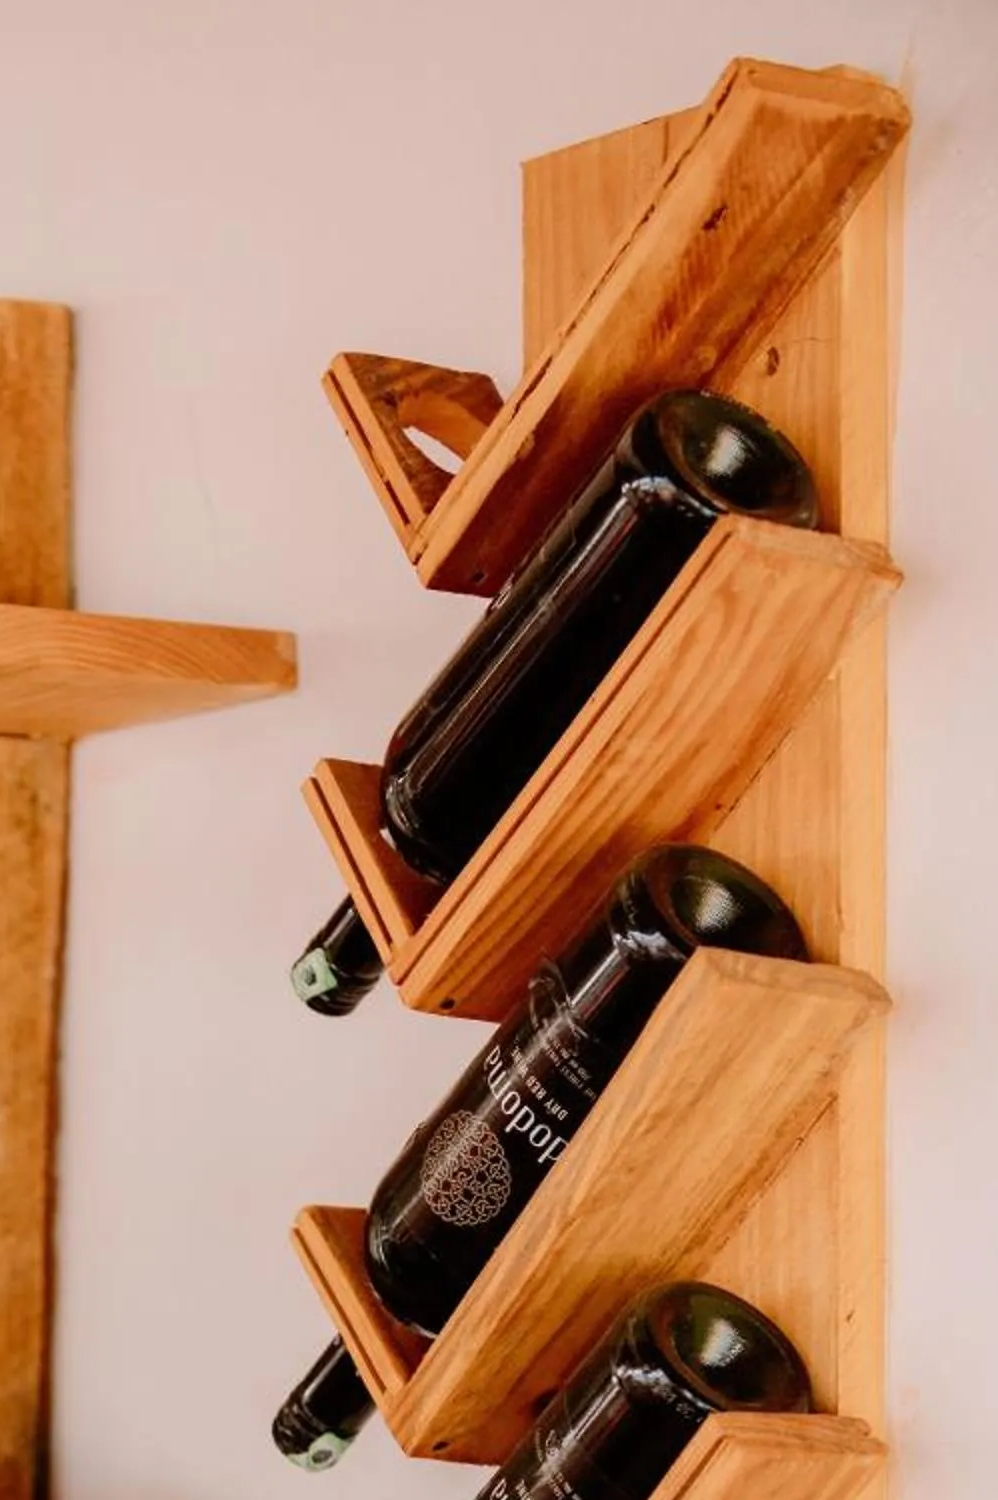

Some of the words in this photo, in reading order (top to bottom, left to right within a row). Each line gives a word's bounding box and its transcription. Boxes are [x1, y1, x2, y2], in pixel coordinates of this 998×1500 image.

[525, 1074, 547, 1100] RED
[484, 1045, 568, 1163] dodoma
[543, 1097, 568, 1120] DRY
